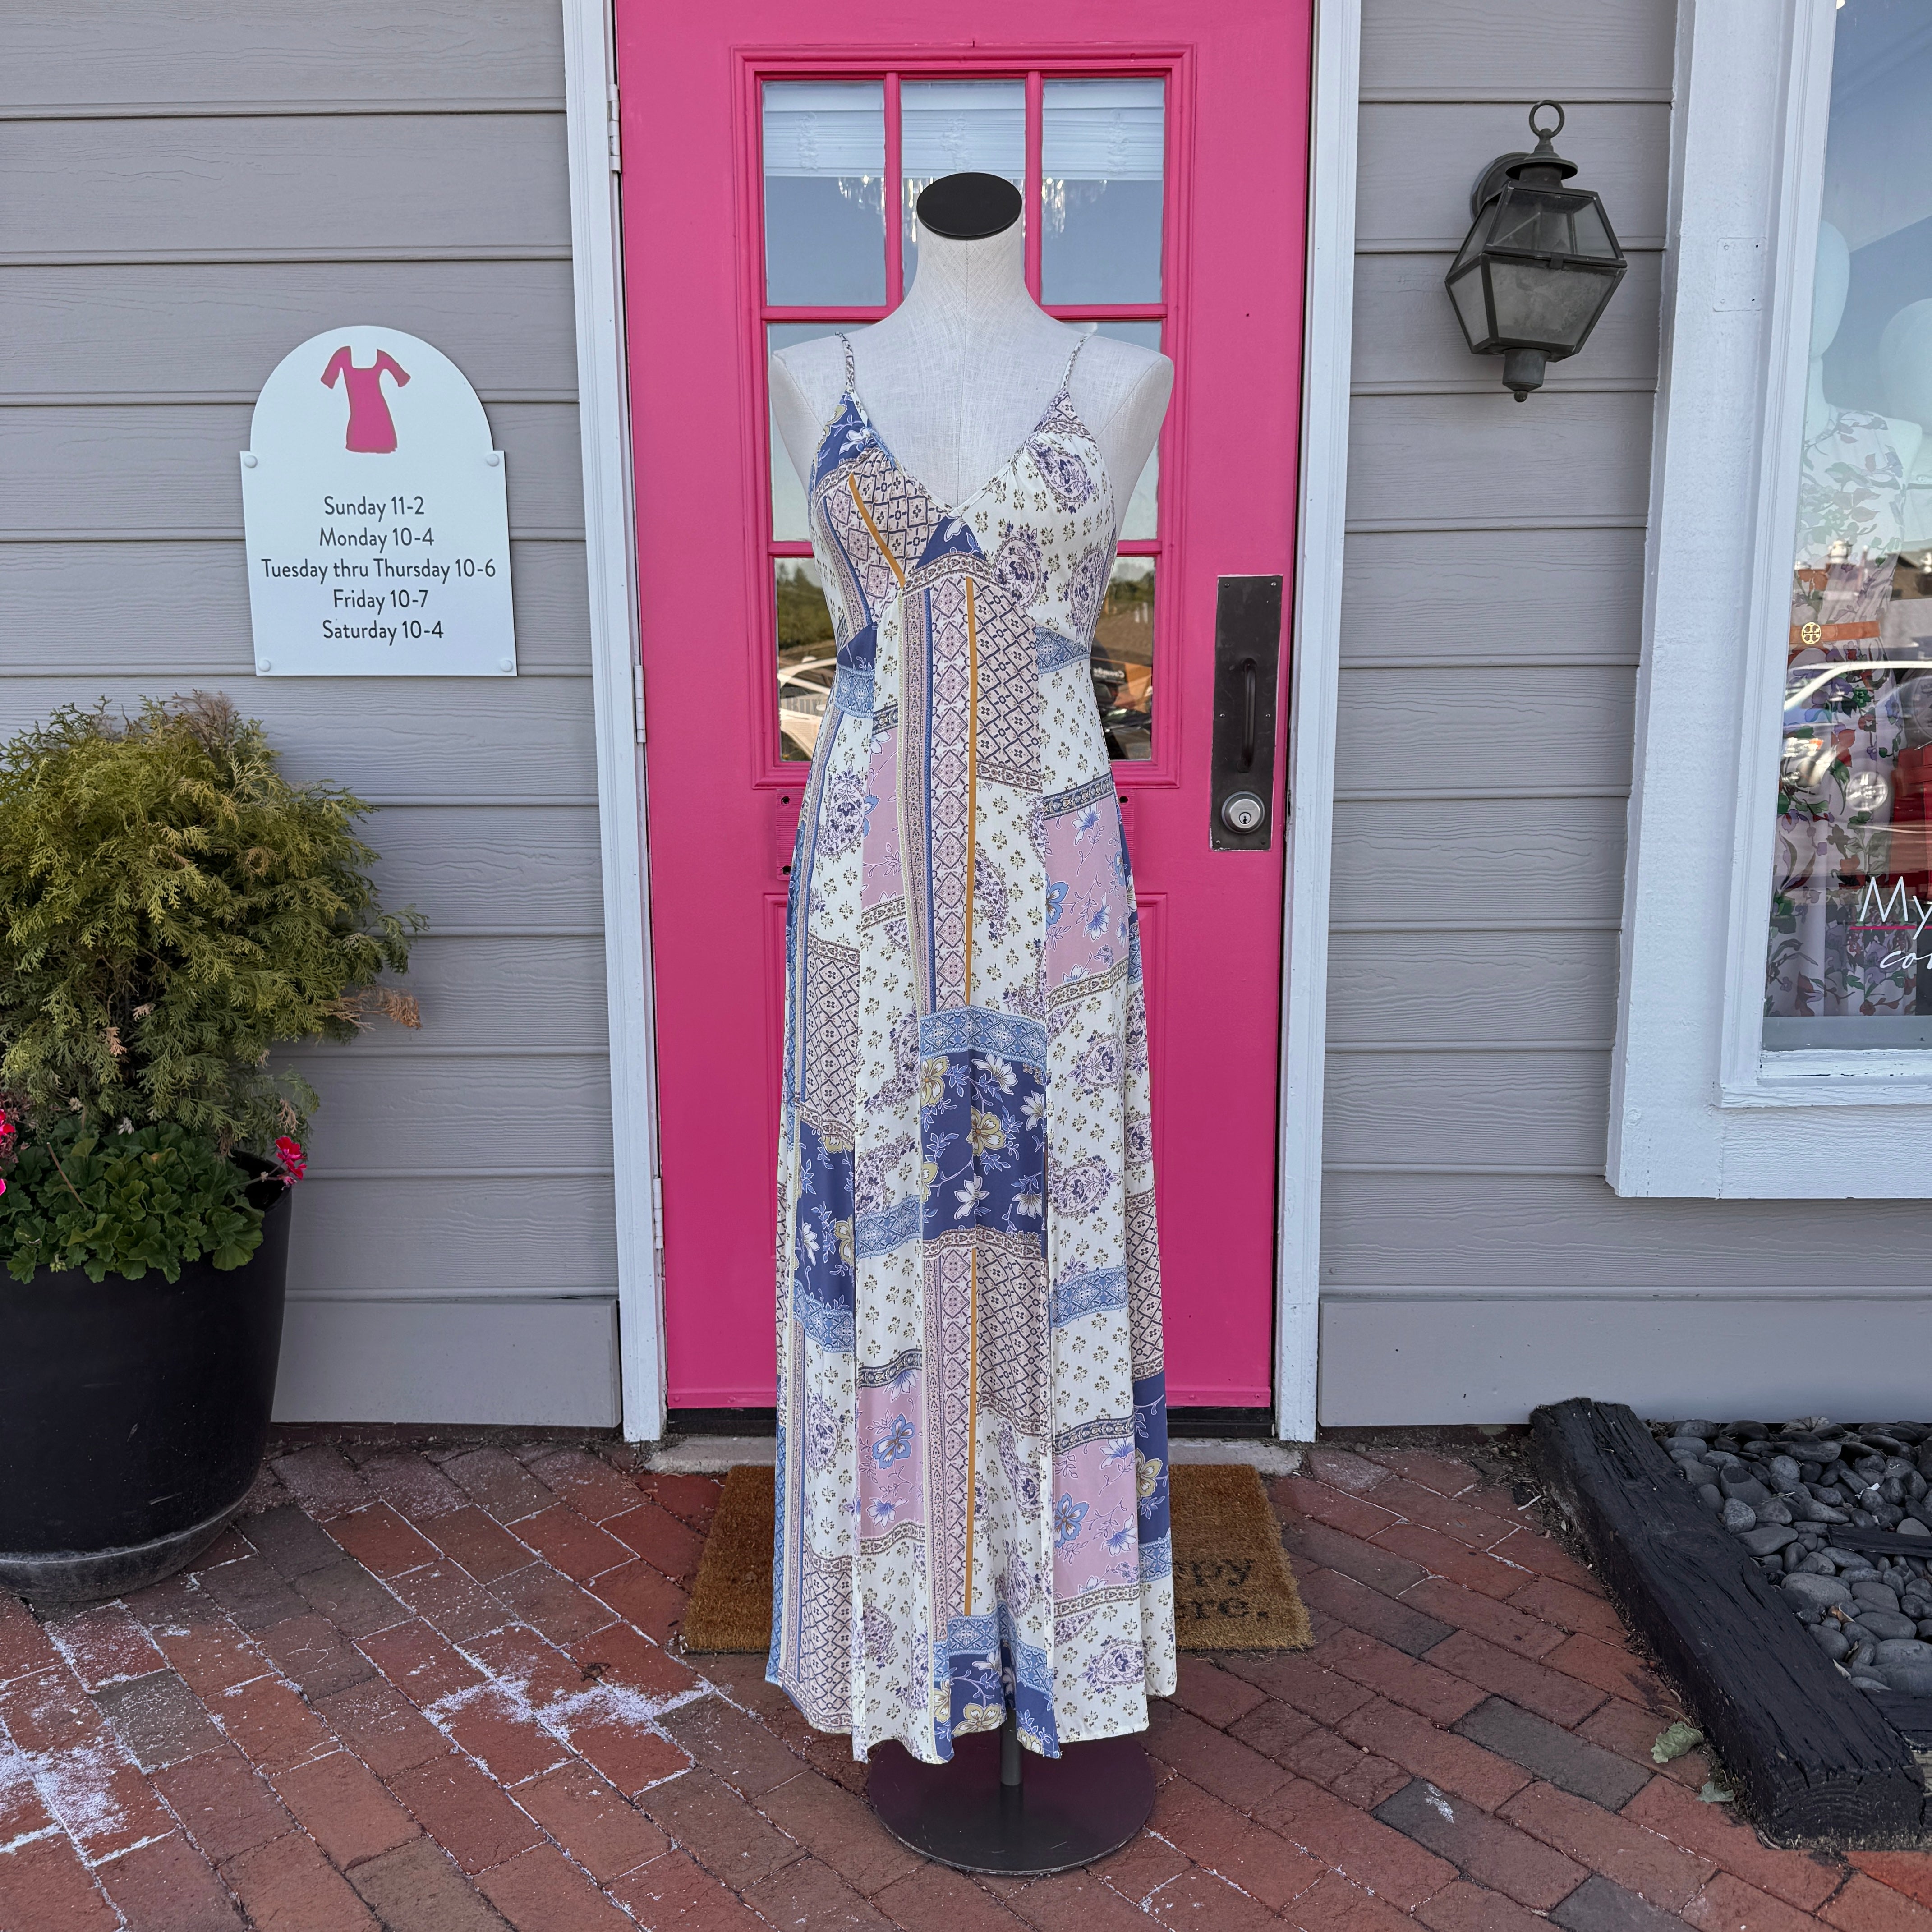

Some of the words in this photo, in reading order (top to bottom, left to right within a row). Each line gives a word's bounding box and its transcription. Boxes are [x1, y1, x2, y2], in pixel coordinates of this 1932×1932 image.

[324, 496, 386, 523] Sunday
[391, 496, 425, 515] 11-2
[319, 527, 387, 554] Monday
[392, 527, 435, 546] 10-4
[261, 558, 328, 585] Tuesday
[333, 558, 369, 577] thru
[373, 558, 450, 585] Thursday
[455, 558, 496, 577] 10-6
[333, 589, 386, 616] Friday
[390, 589, 429, 608] 10-7
[322, 620, 397, 646] Saturday
[401, 620, 444, 639] 10-4
[1859, 876, 1932, 940] My
[1879, 950, 1932, 970] co
